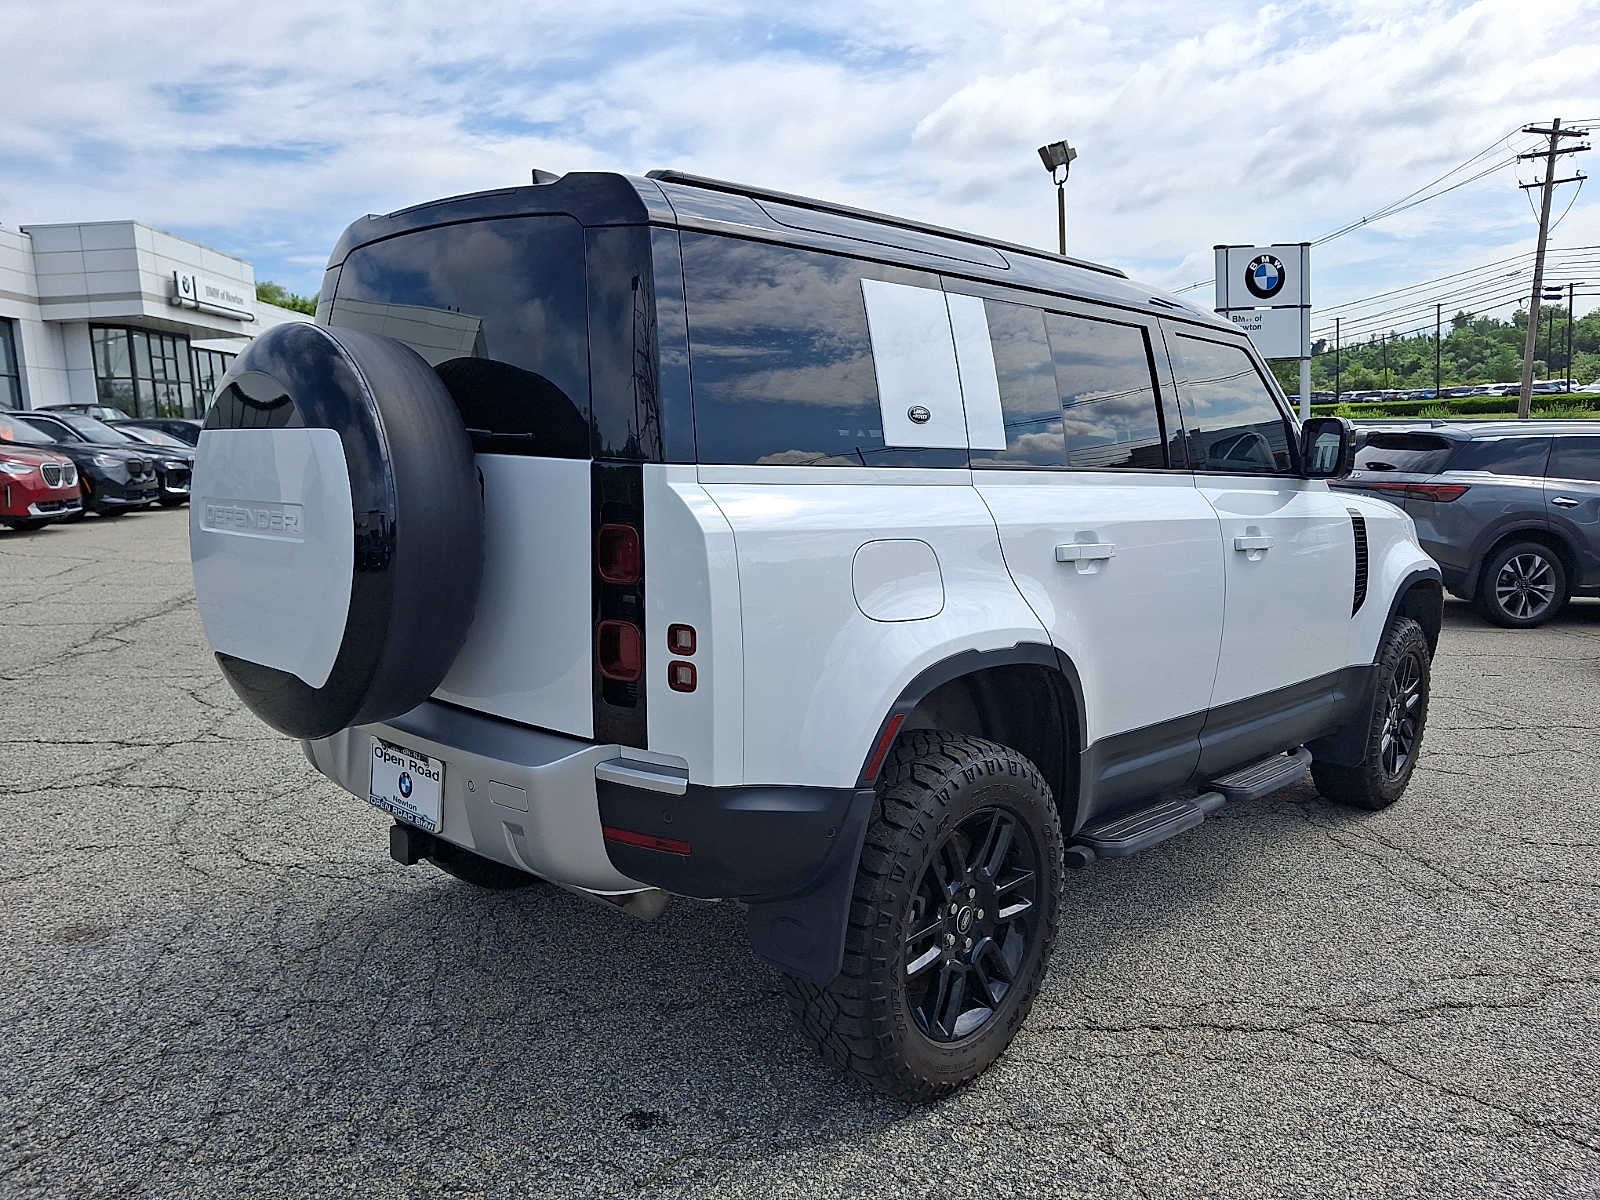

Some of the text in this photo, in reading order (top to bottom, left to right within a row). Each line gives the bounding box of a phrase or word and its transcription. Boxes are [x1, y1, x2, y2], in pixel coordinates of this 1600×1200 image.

[1249, 255, 1283, 271] BMW
[1254, 314, 1262, 322] of
[206, 504, 300, 534] DEFENDER
[374, 746, 405, 767] Open
[409, 759, 440, 782] Road
[370, 796, 436, 832] OPEN ROAD BMW
[392, 795, 417, 812] Newton
